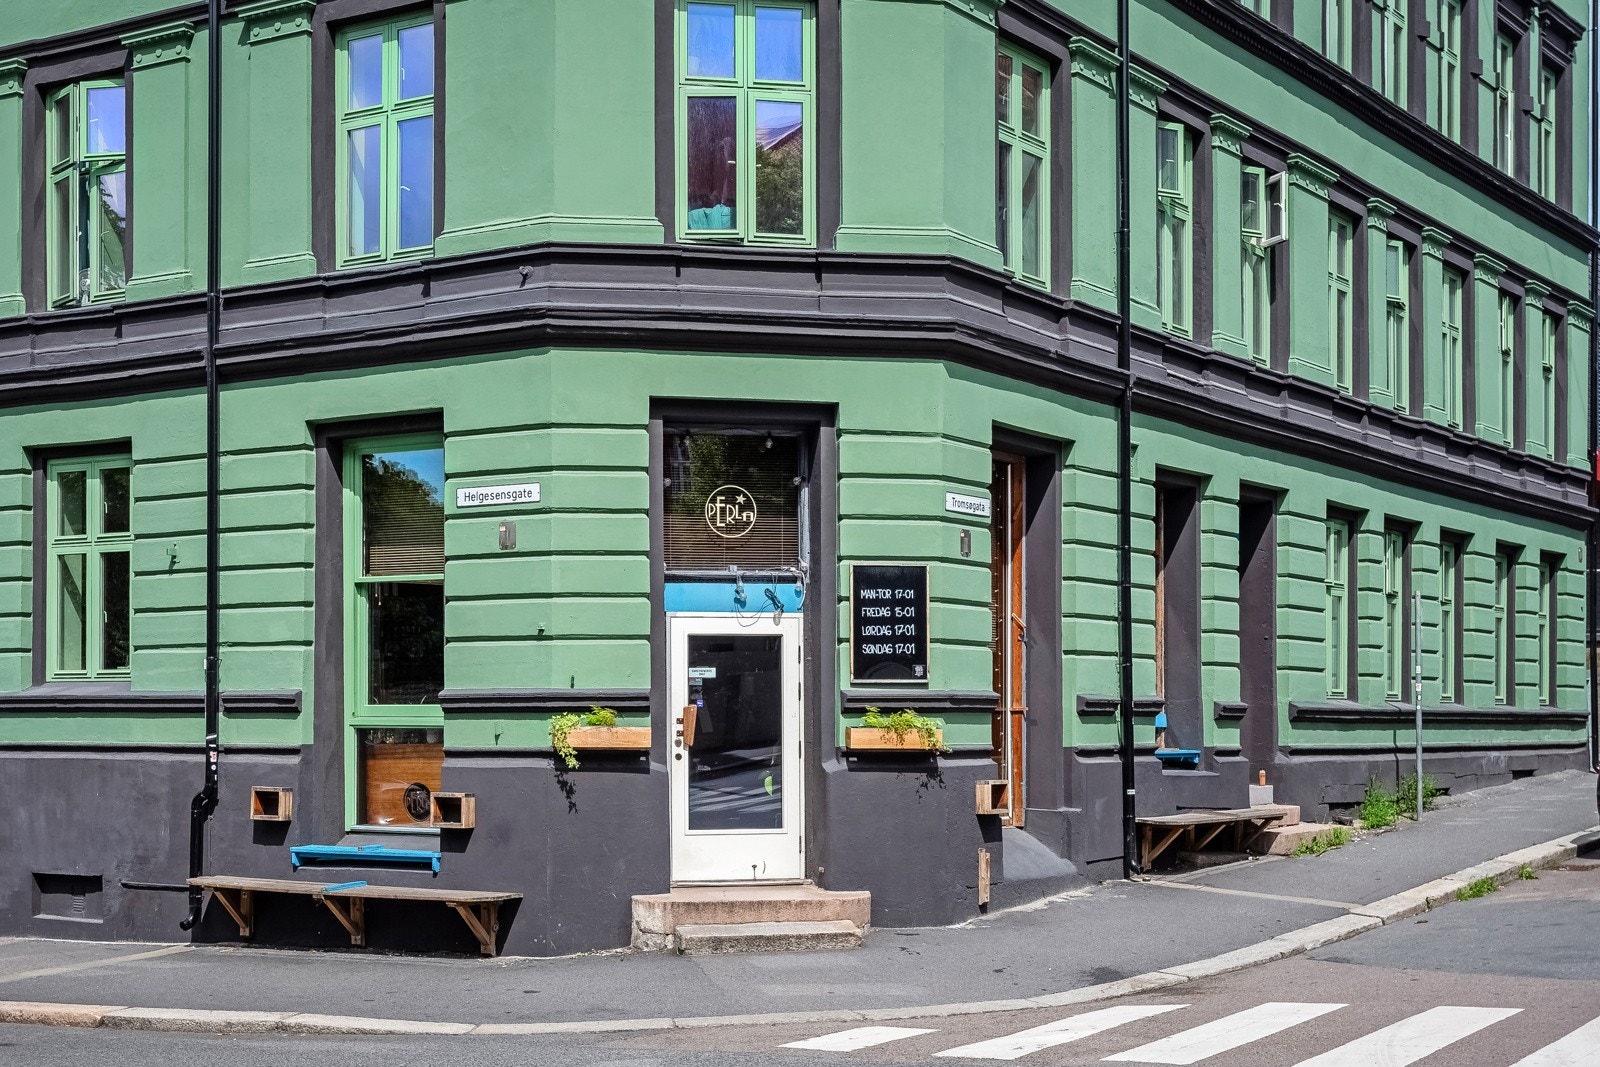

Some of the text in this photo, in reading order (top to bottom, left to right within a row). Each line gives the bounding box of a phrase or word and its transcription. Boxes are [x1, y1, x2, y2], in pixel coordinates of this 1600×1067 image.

[464, 489, 532, 503] Helgesensgate
[952, 497, 985, 512] Tromsøgata
[860, 589, 914, 599] MAN-TOR 17-01
[861, 606, 915, 617] FREDAG 15-01
[861, 624, 915, 636] LØRDAG 17-01
[862, 643, 915, 655] SØNDAG 17-01
